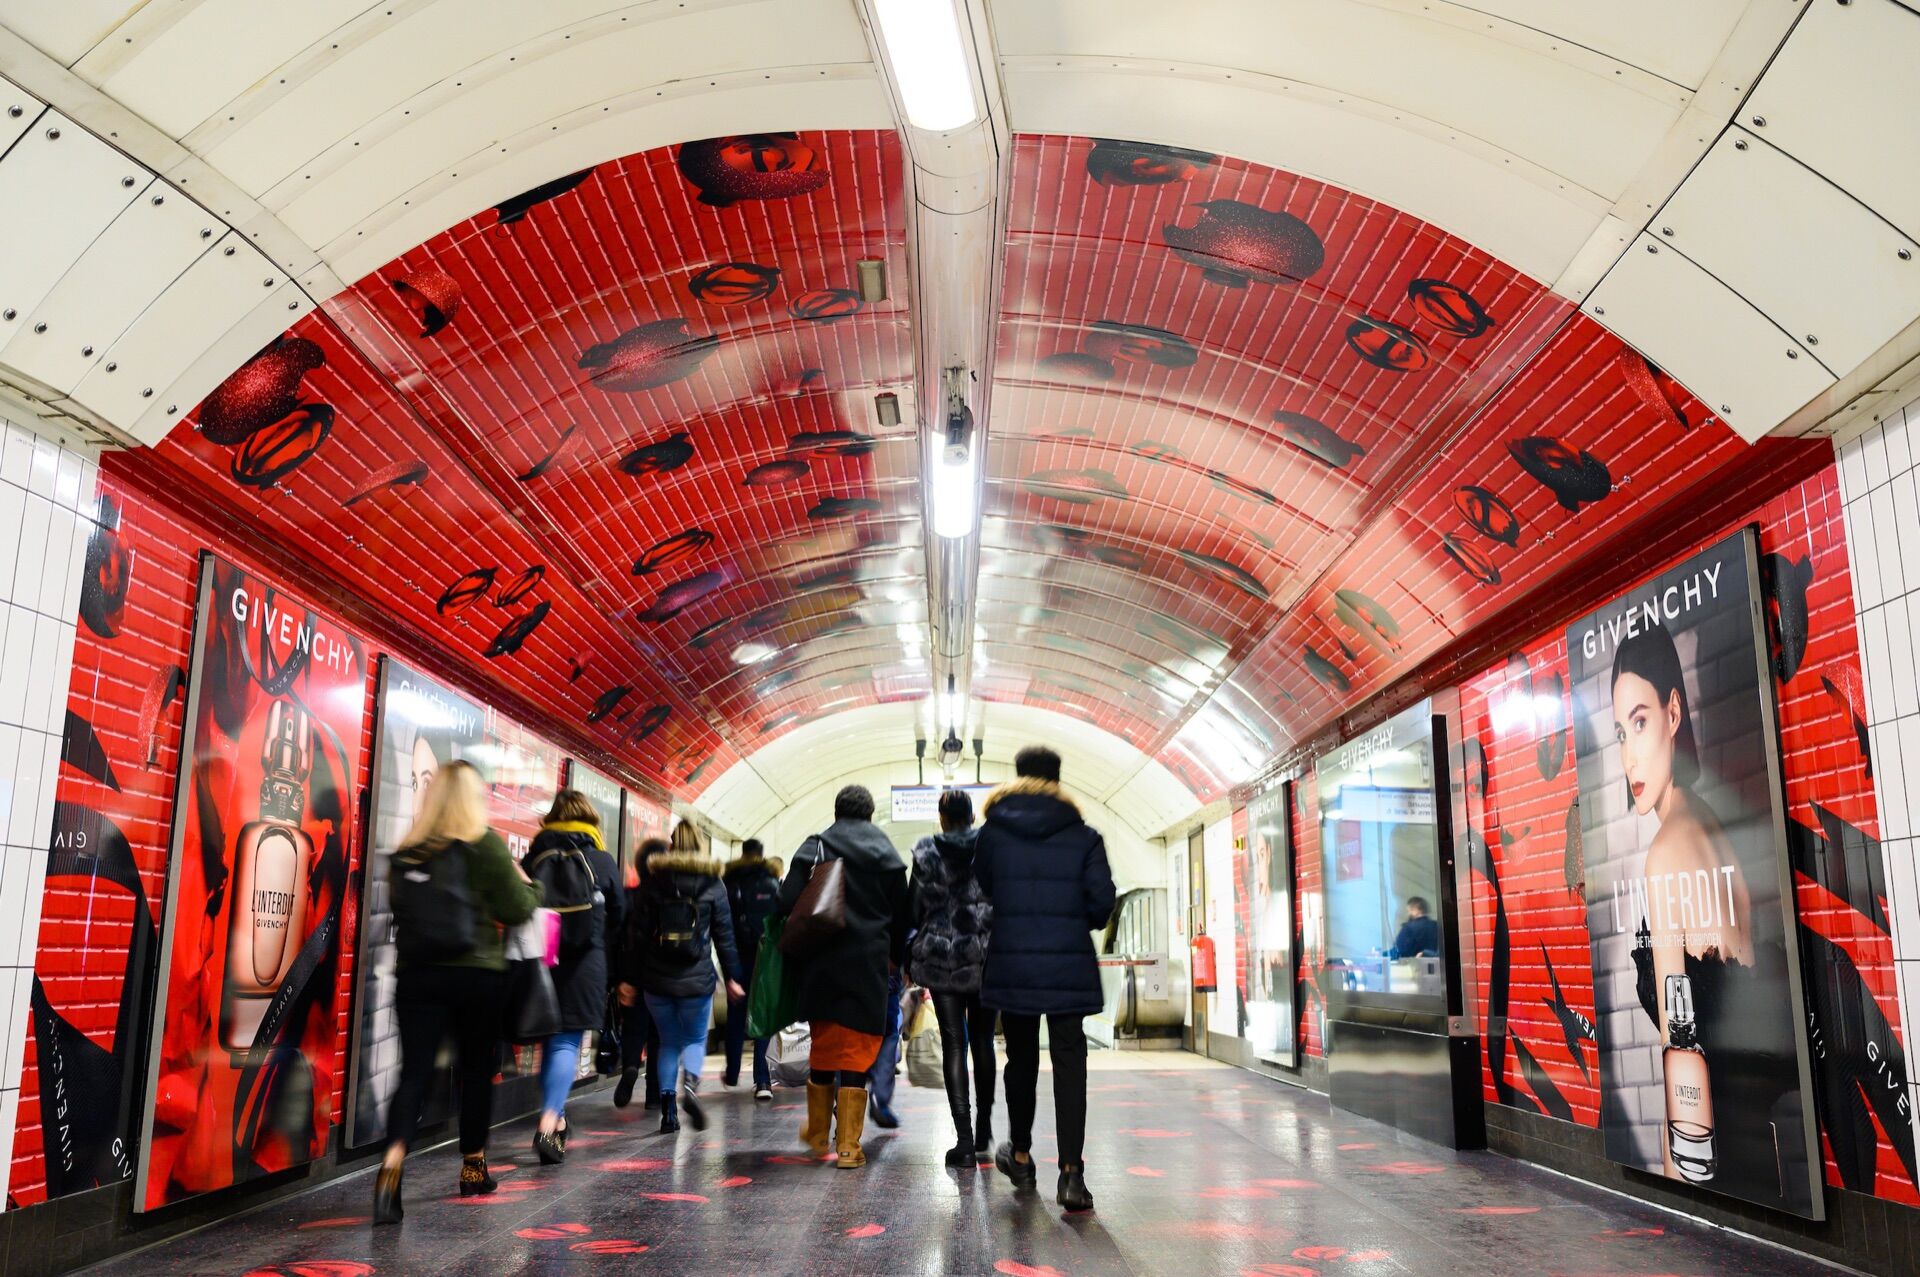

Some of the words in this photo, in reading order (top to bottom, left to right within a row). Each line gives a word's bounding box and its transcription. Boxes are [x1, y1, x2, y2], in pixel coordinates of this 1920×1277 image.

[231, 588, 354, 675] GIVENCHY
[1583, 561, 1722, 660] GIVENCHY
[1340, 726, 1393, 770] GIVENCHY
[251, 889, 296, 917] L'INTERDIT
[256, 918, 288, 929] GIVENCHY
[1613, 865, 1736, 933] L'INTERDIT
[1867, 1040, 1912, 1125] GIVE
